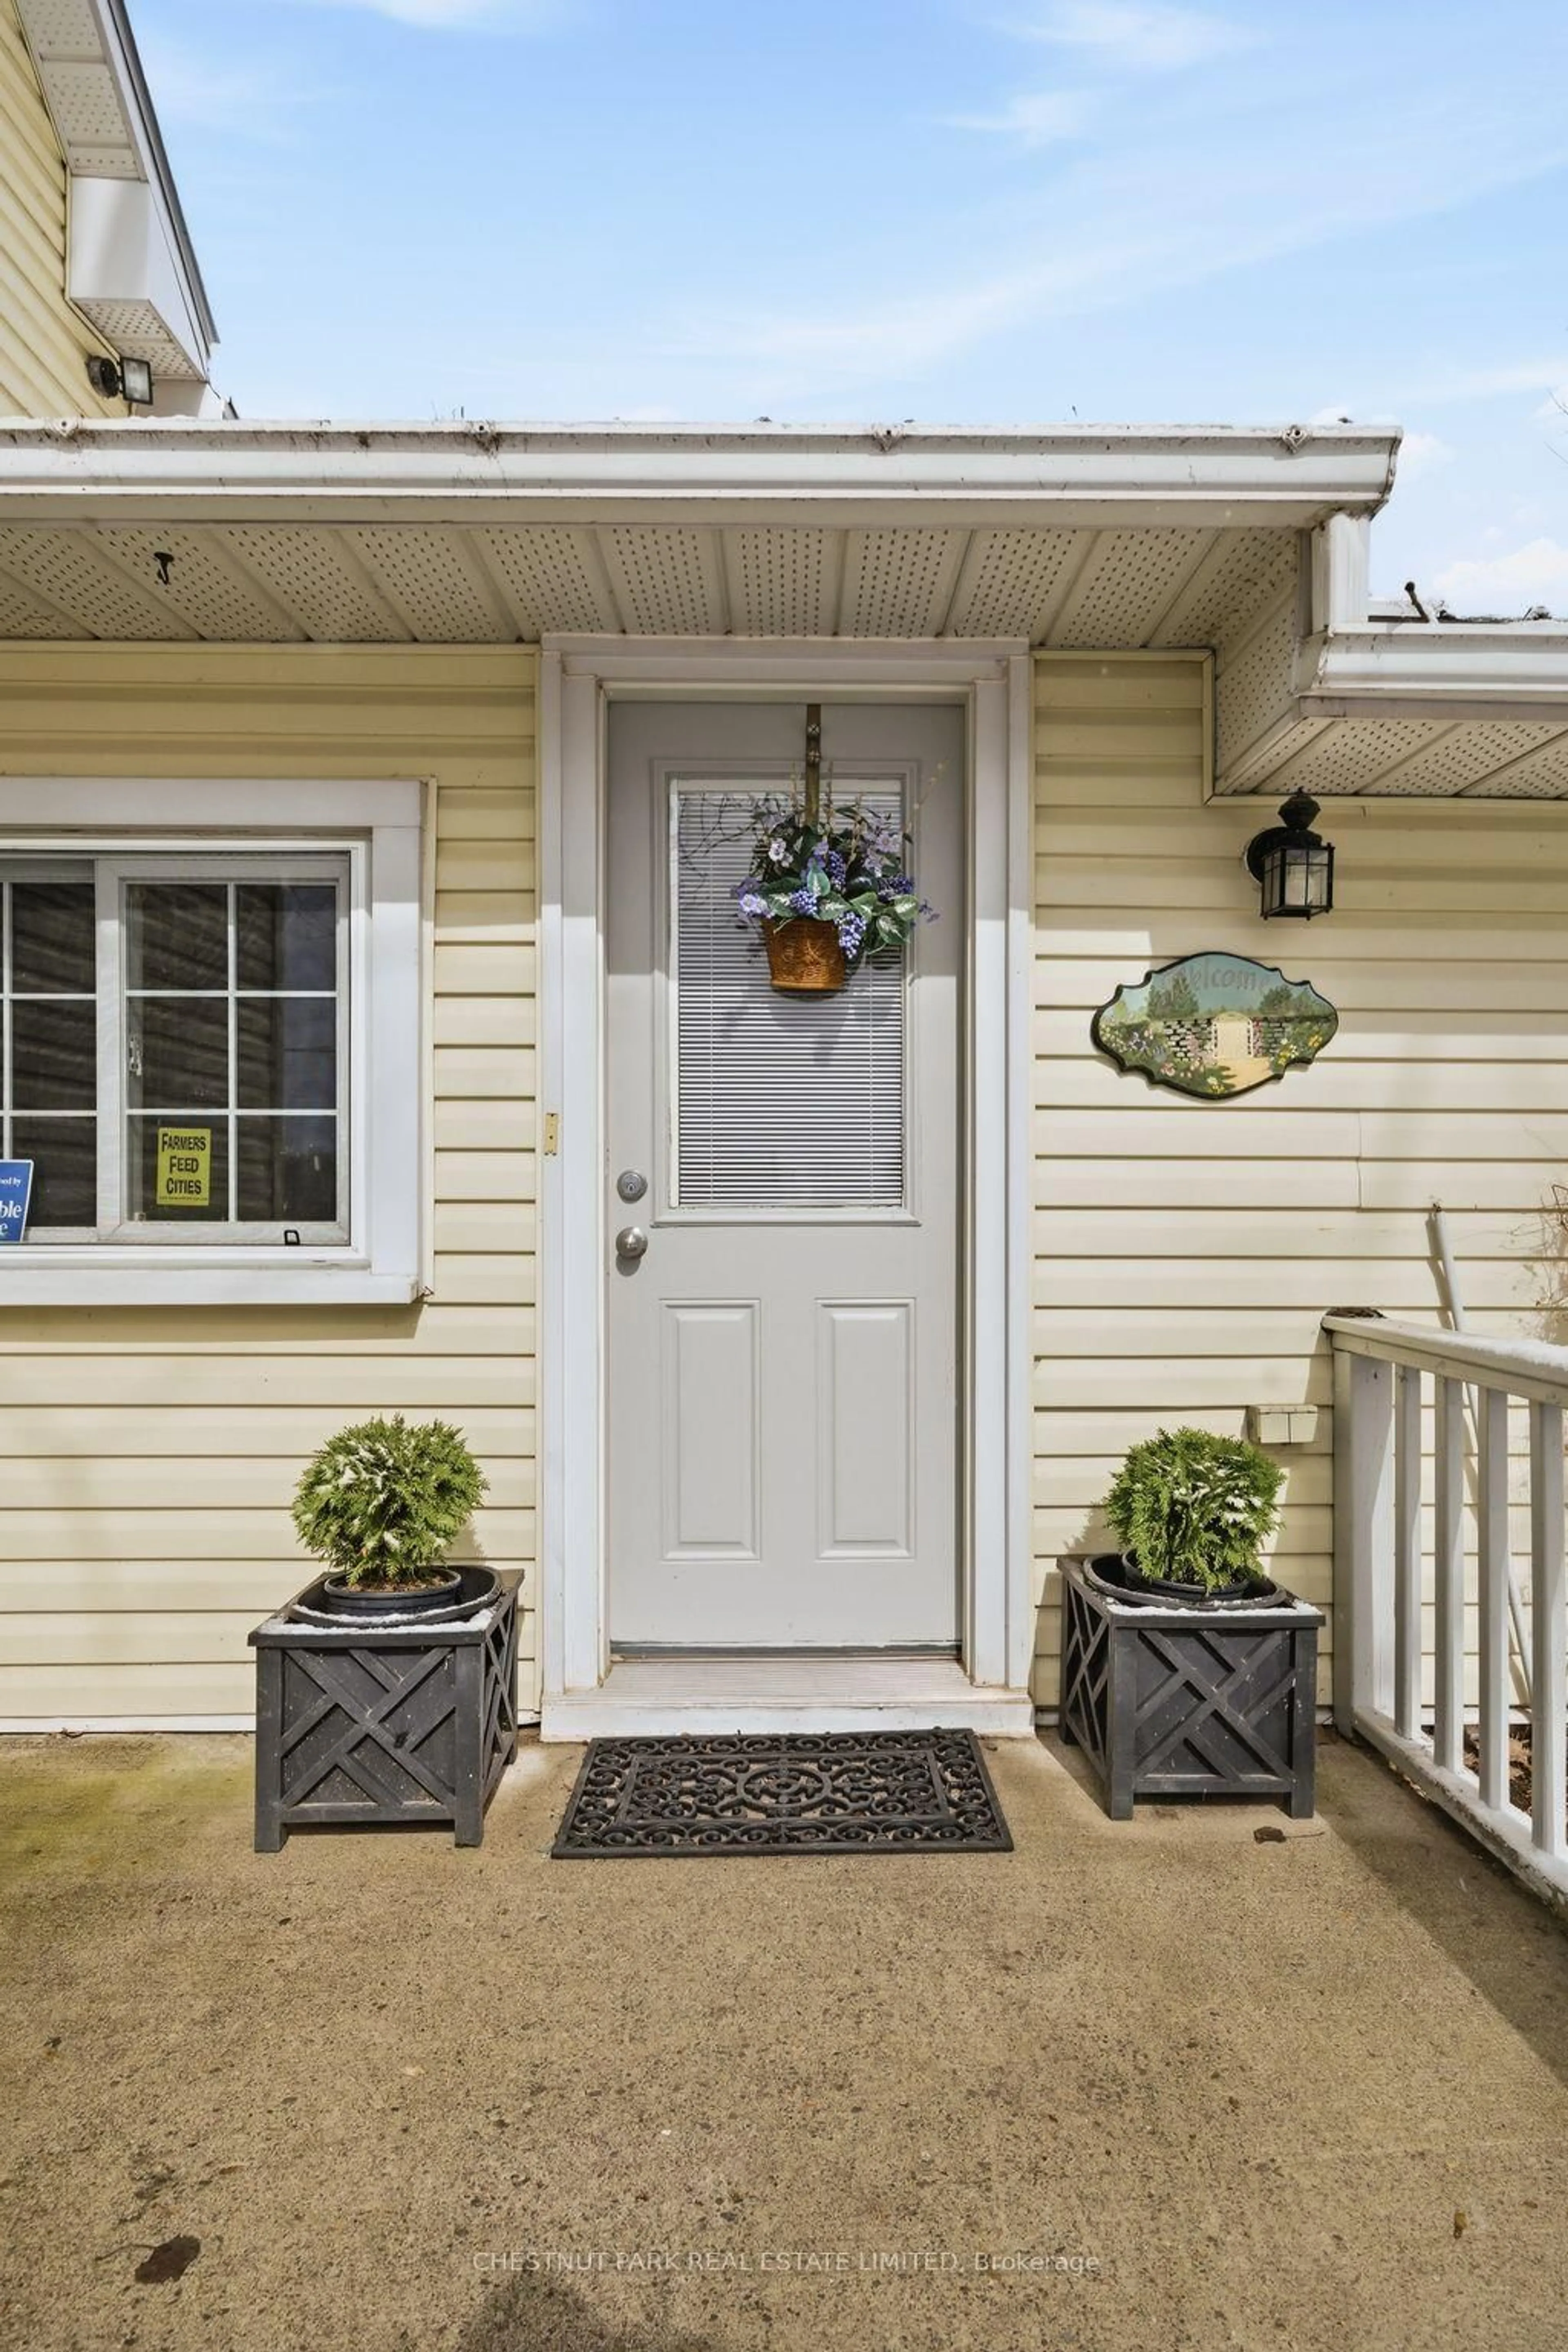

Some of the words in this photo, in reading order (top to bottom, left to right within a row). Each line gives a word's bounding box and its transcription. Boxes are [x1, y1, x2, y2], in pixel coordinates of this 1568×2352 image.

[162, 1133, 206, 1152] FARMERS
[170, 1156, 199, 1174] FEED
[167, 1178, 202, 1194] CITIES
